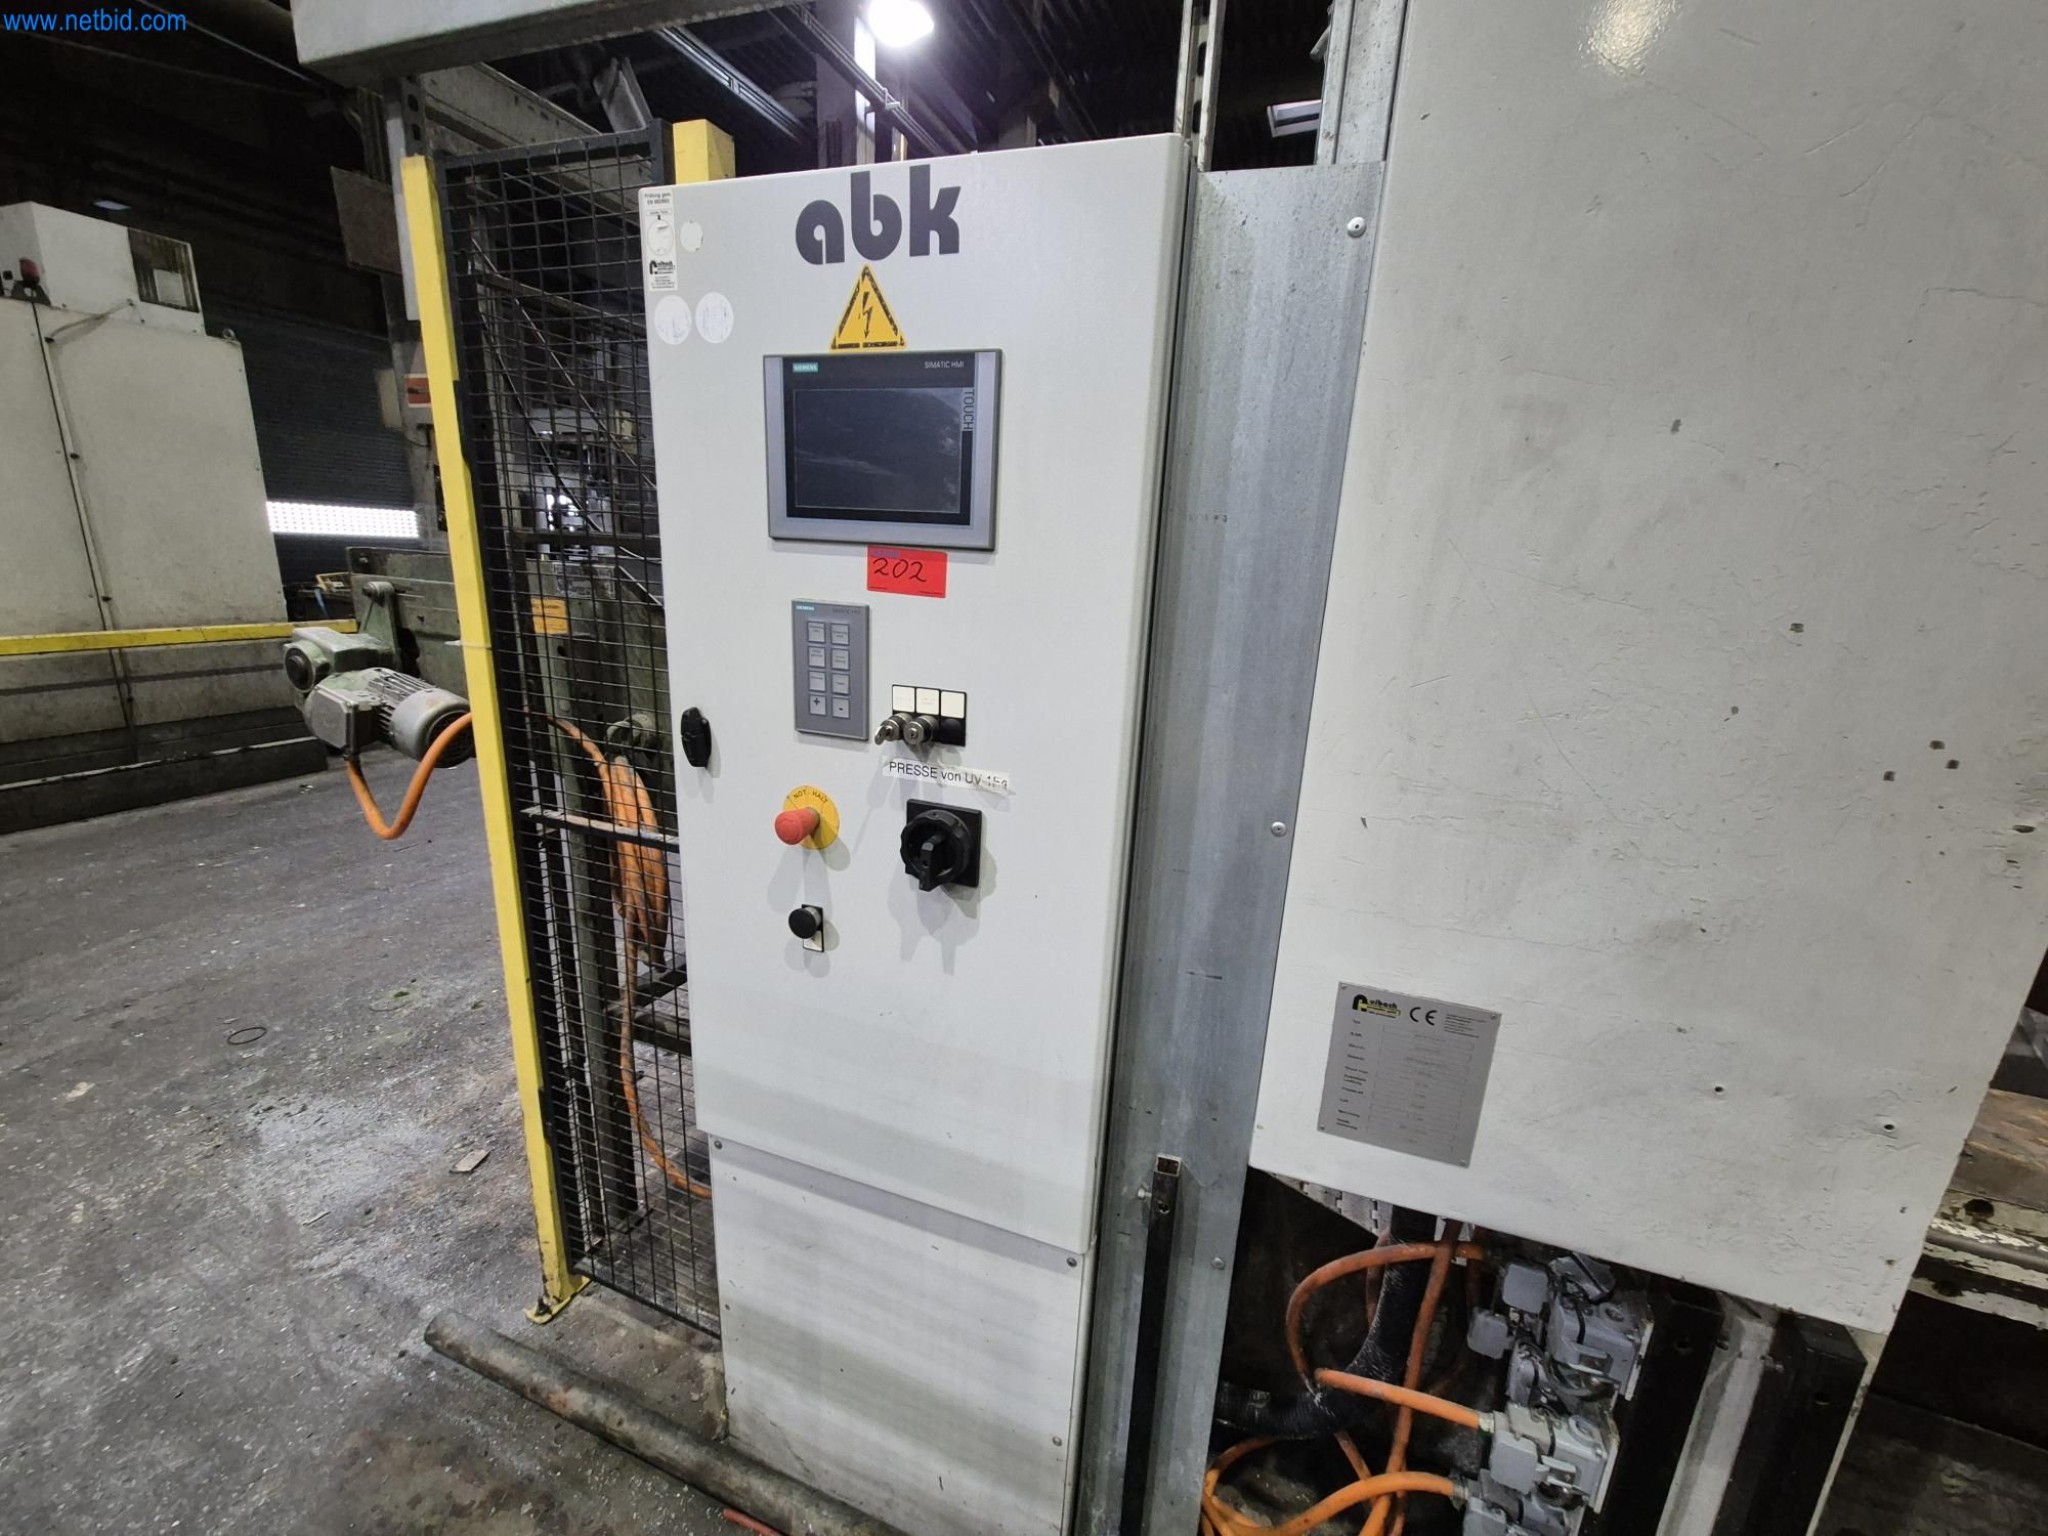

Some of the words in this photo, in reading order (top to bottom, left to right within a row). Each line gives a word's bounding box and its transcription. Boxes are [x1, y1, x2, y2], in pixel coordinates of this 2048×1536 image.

[796, 164, 961, 265] abk
[924, 361, 950, 369] SIMATIC
[963, 390, 975, 431] TOUCH
[873, 557, 927, 582] 202
[889, 761, 938, 778] PRESSE
[940, 770, 961, 781] von
[793, 789, 806, 799] NOT
